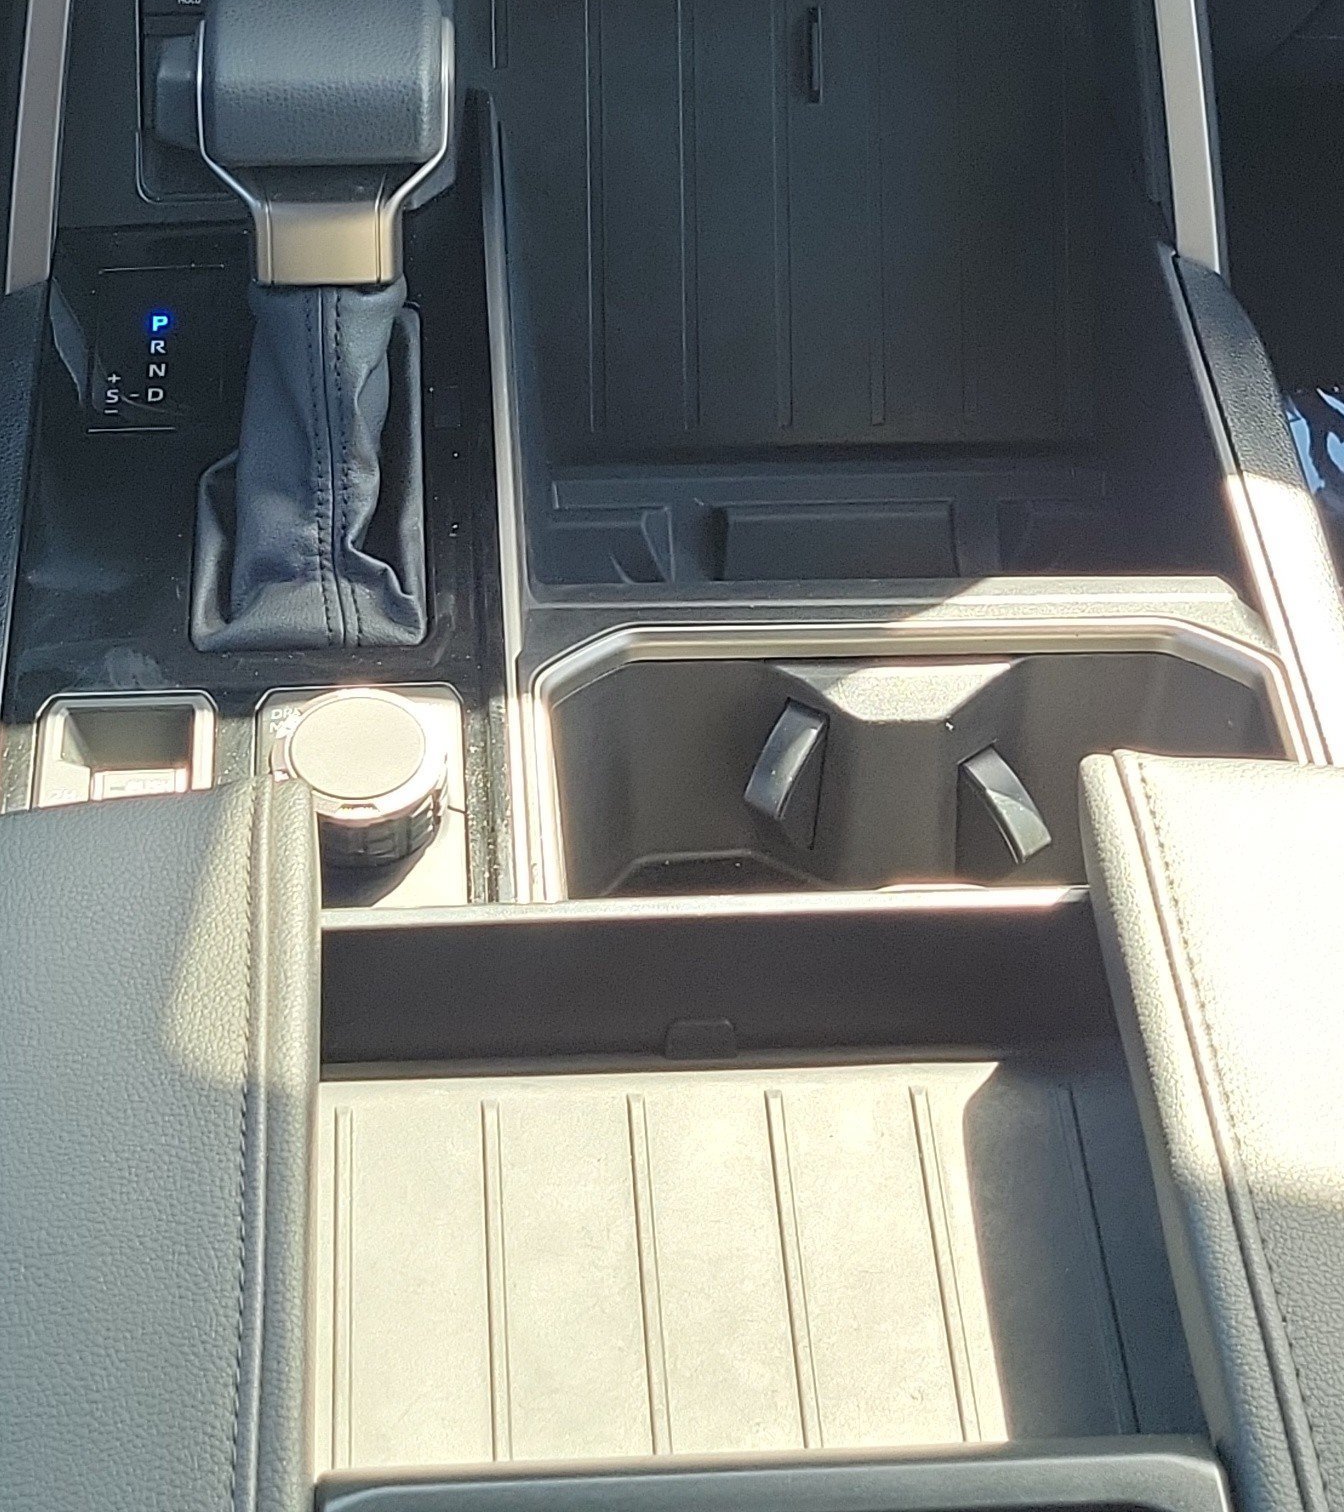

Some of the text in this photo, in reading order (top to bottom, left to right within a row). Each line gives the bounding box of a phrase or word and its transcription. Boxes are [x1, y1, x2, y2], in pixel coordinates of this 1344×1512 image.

[152, 315, 168, 332] P
[150, 340, 166, 355] R
[148, 363, 166, 377] N
[105, 389, 119, 404] S
[147, 387, 164, 402] D
